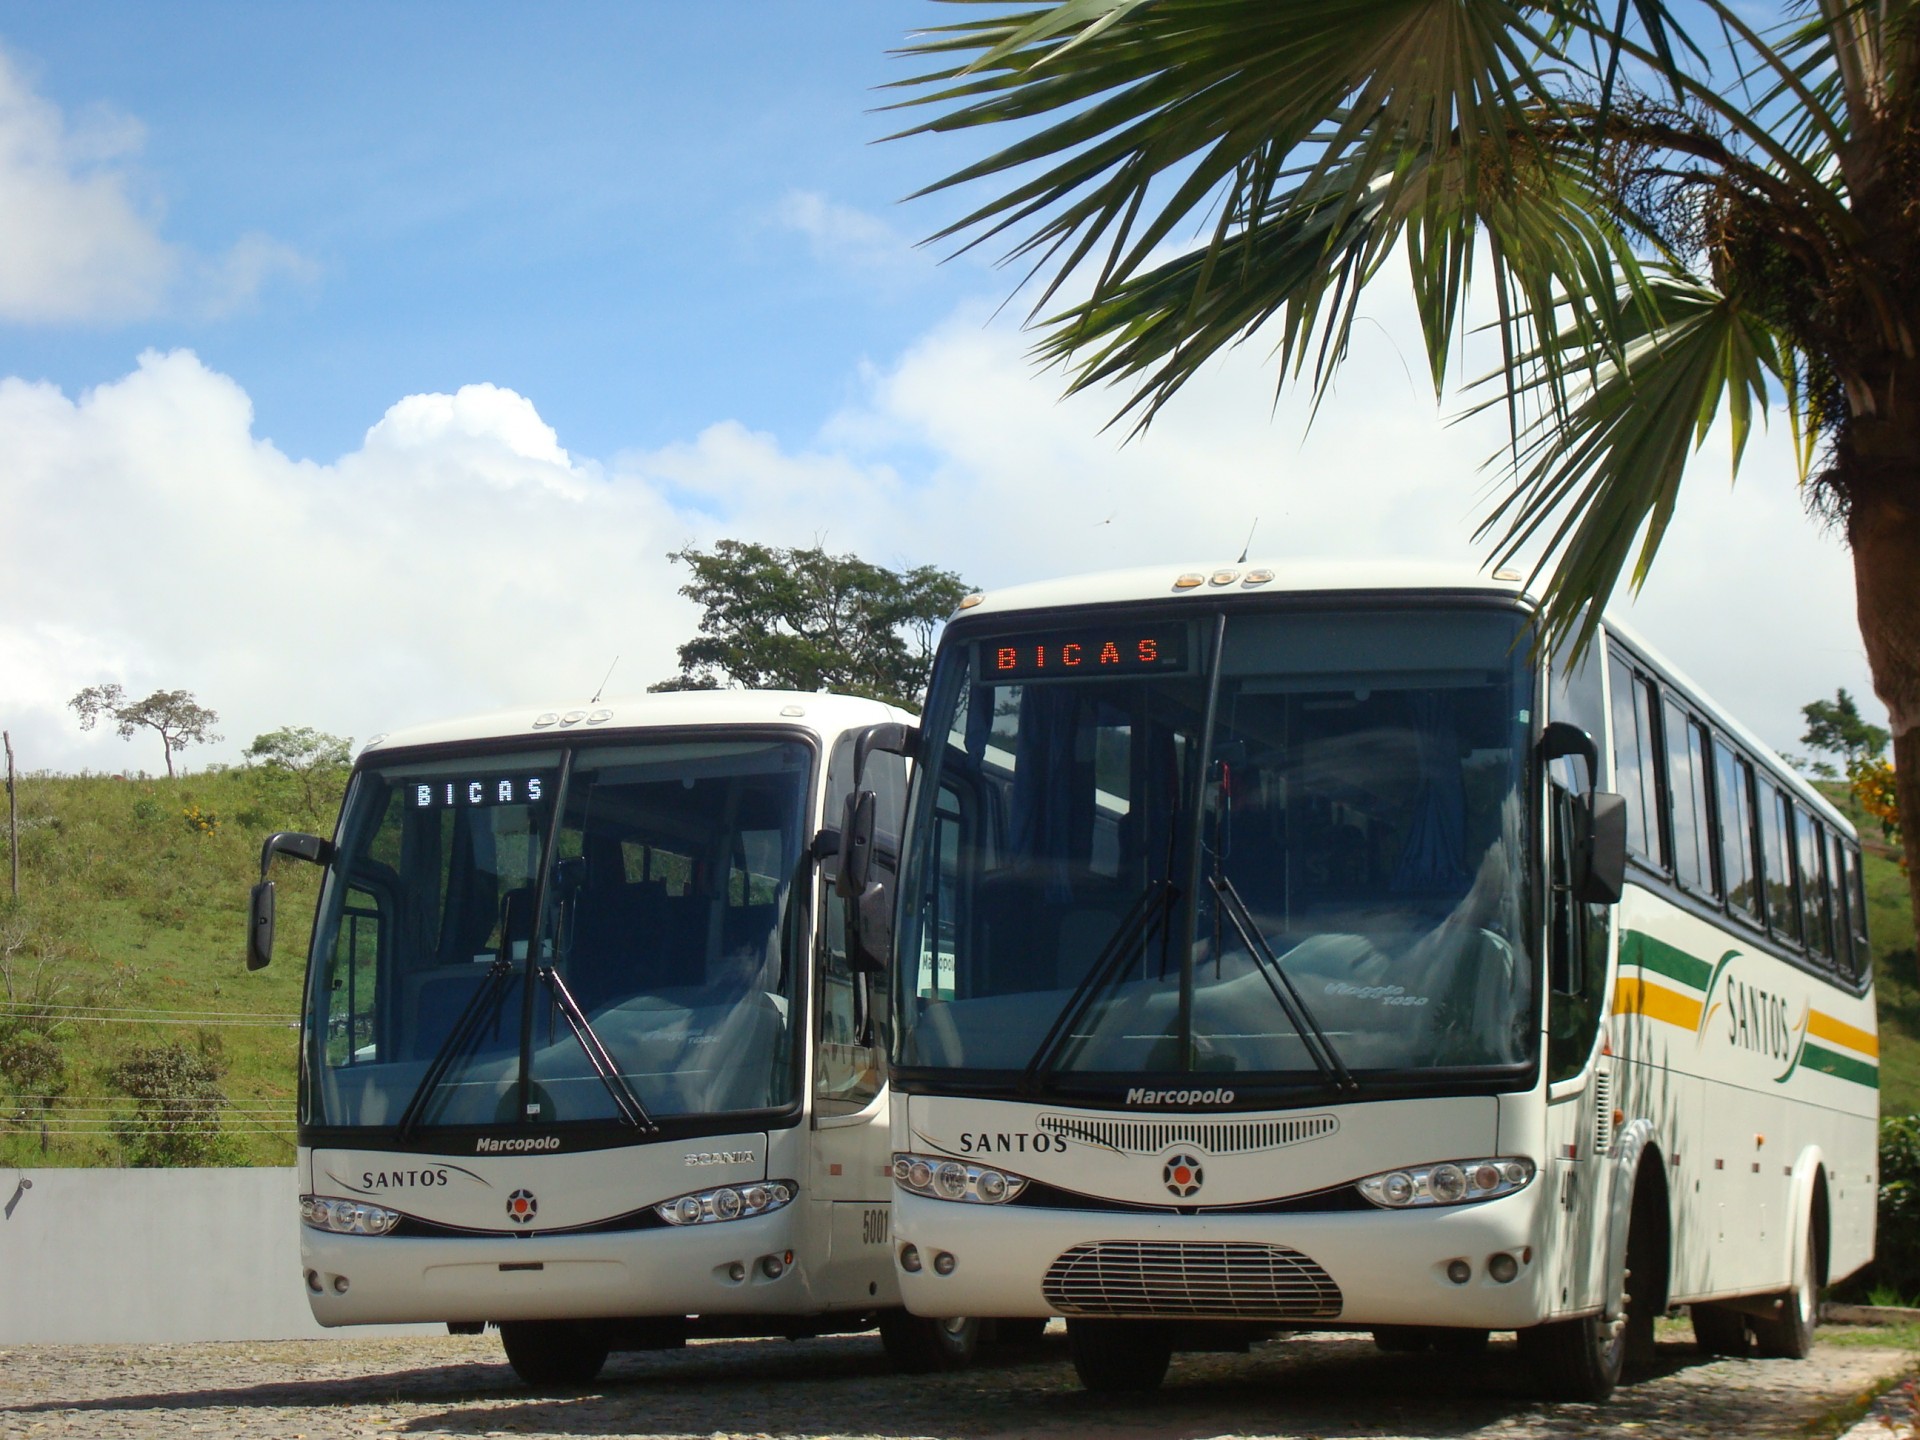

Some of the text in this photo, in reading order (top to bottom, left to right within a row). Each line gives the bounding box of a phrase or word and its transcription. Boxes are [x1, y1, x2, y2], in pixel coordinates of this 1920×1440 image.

[999, 639, 1157, 669] BICAS
[417, 778, 541, 806] BICAS
[1727, 973, 1789, 1062] SANTOS
[1126, 1088, 1235, 1106] Marcopolo
[476, 1136, 561, 1152] Marcopolo
[960, 1132, 1068, 1153] SANTOS
[684, 1150, 756, 1167] SCANIA
[362, 1169, 449, 1189] SANTOS
[863, 1208, 889, 1245] 5001
